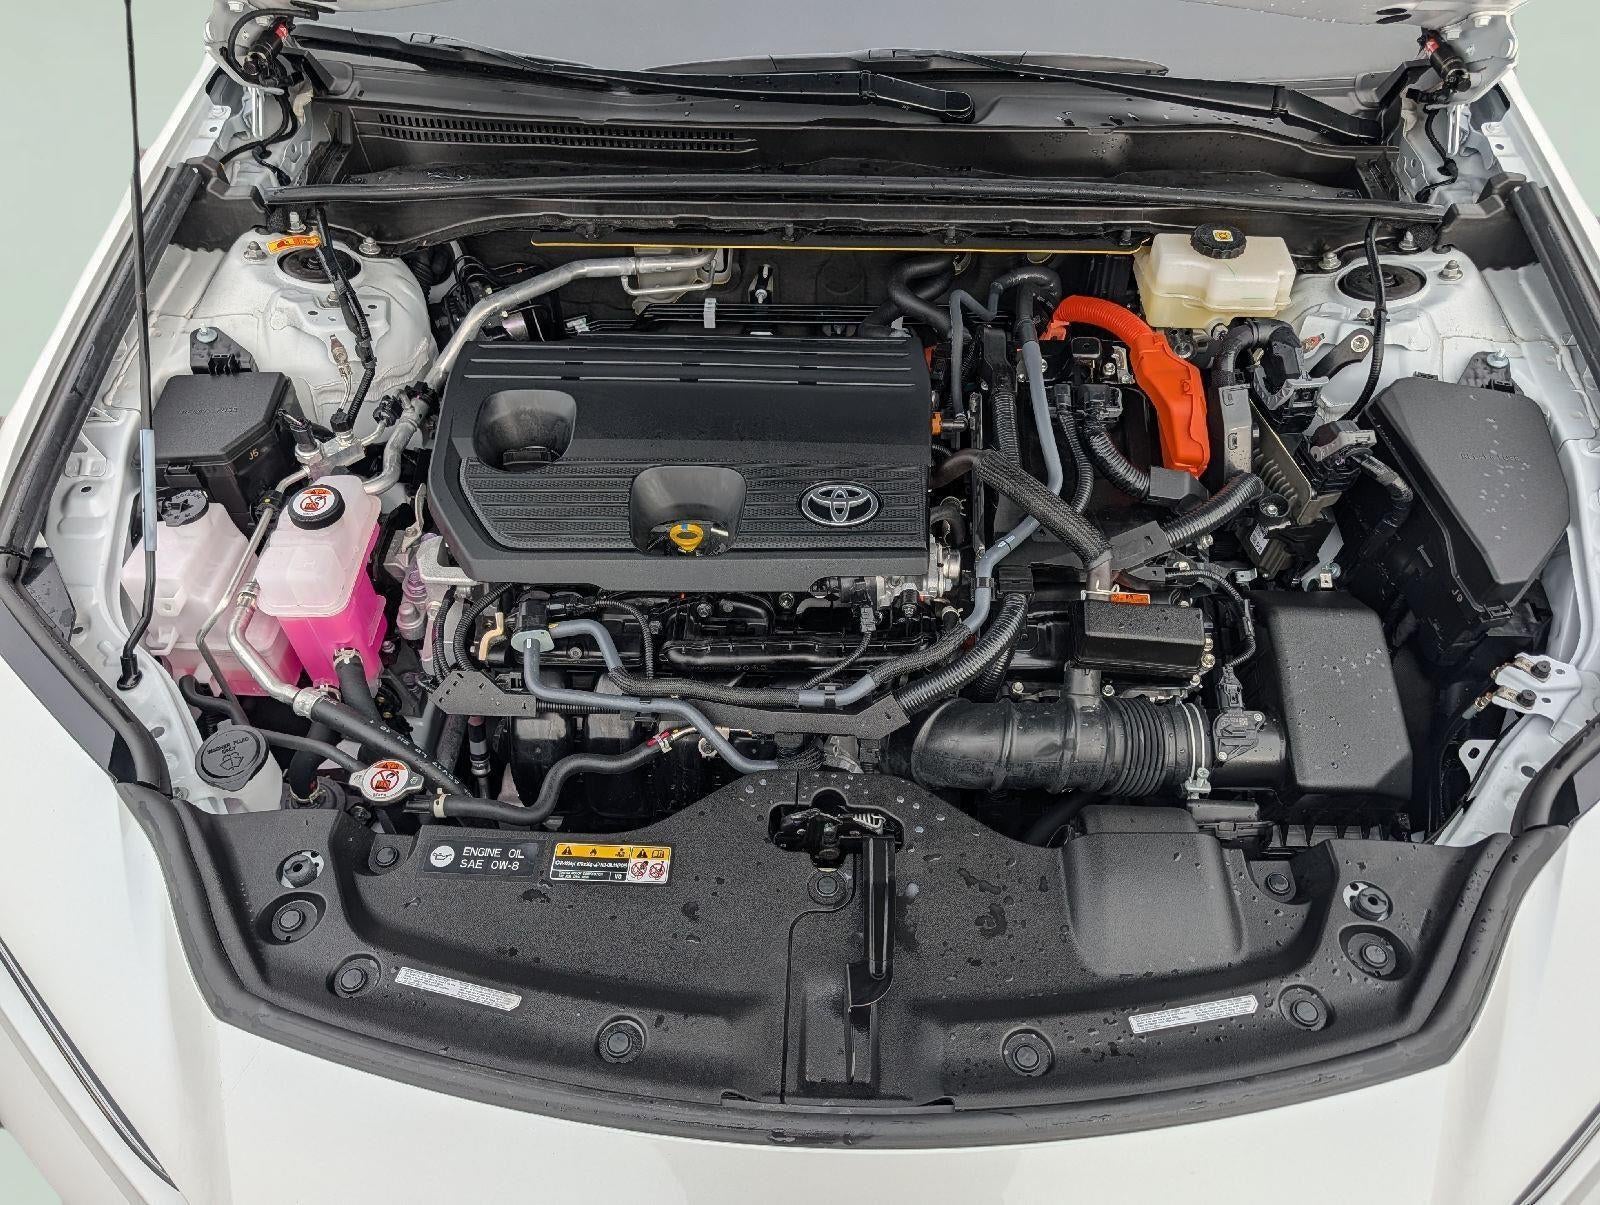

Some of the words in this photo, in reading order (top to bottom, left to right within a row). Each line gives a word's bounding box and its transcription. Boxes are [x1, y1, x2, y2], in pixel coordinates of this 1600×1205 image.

[249, 448, 259, 460] J5
[463, 846, 502, 858] ENGINE
[508, 848, 525, 859] OIL
[459, 859, 484, 869] SAE
[490, 860, 520, 871] 0W-8
